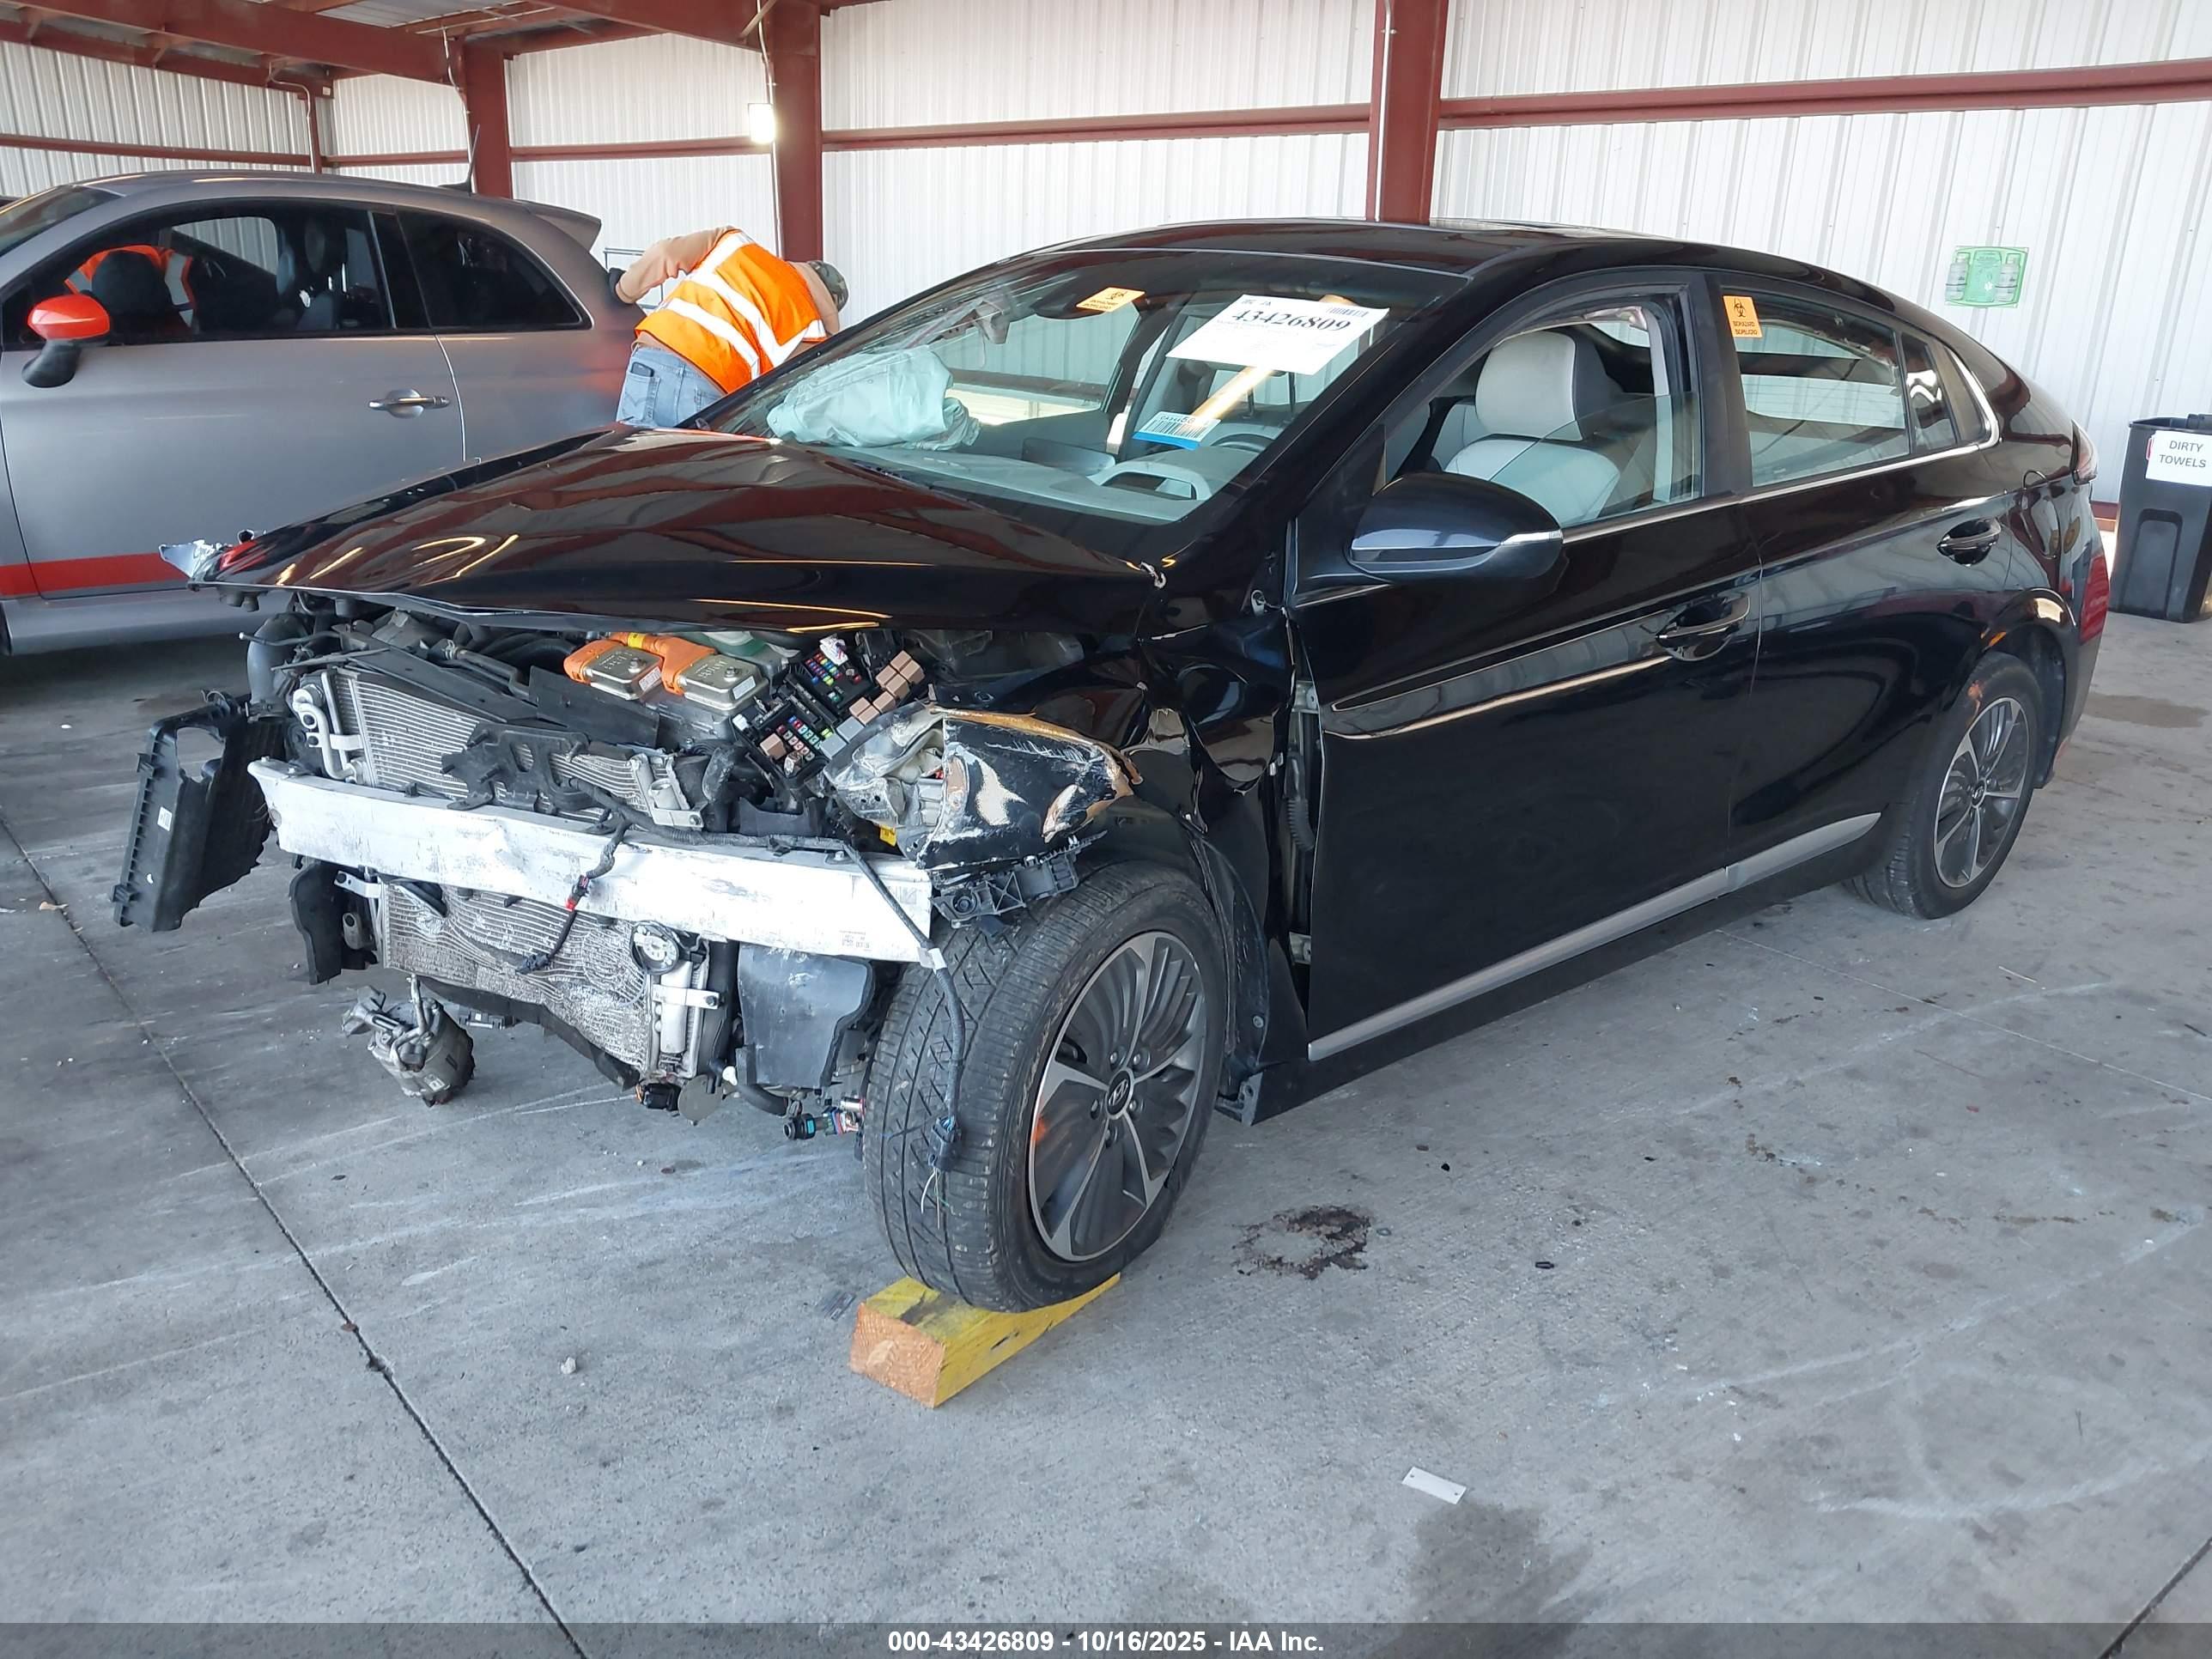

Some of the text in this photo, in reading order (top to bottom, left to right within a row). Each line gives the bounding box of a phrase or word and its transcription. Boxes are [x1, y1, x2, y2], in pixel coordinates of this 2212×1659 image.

[1232, 309, 1352, 331] 43426809
[2169, 440, 2204, 453] DIRTY
[2159, 453, 2207, 468] TOWELS
